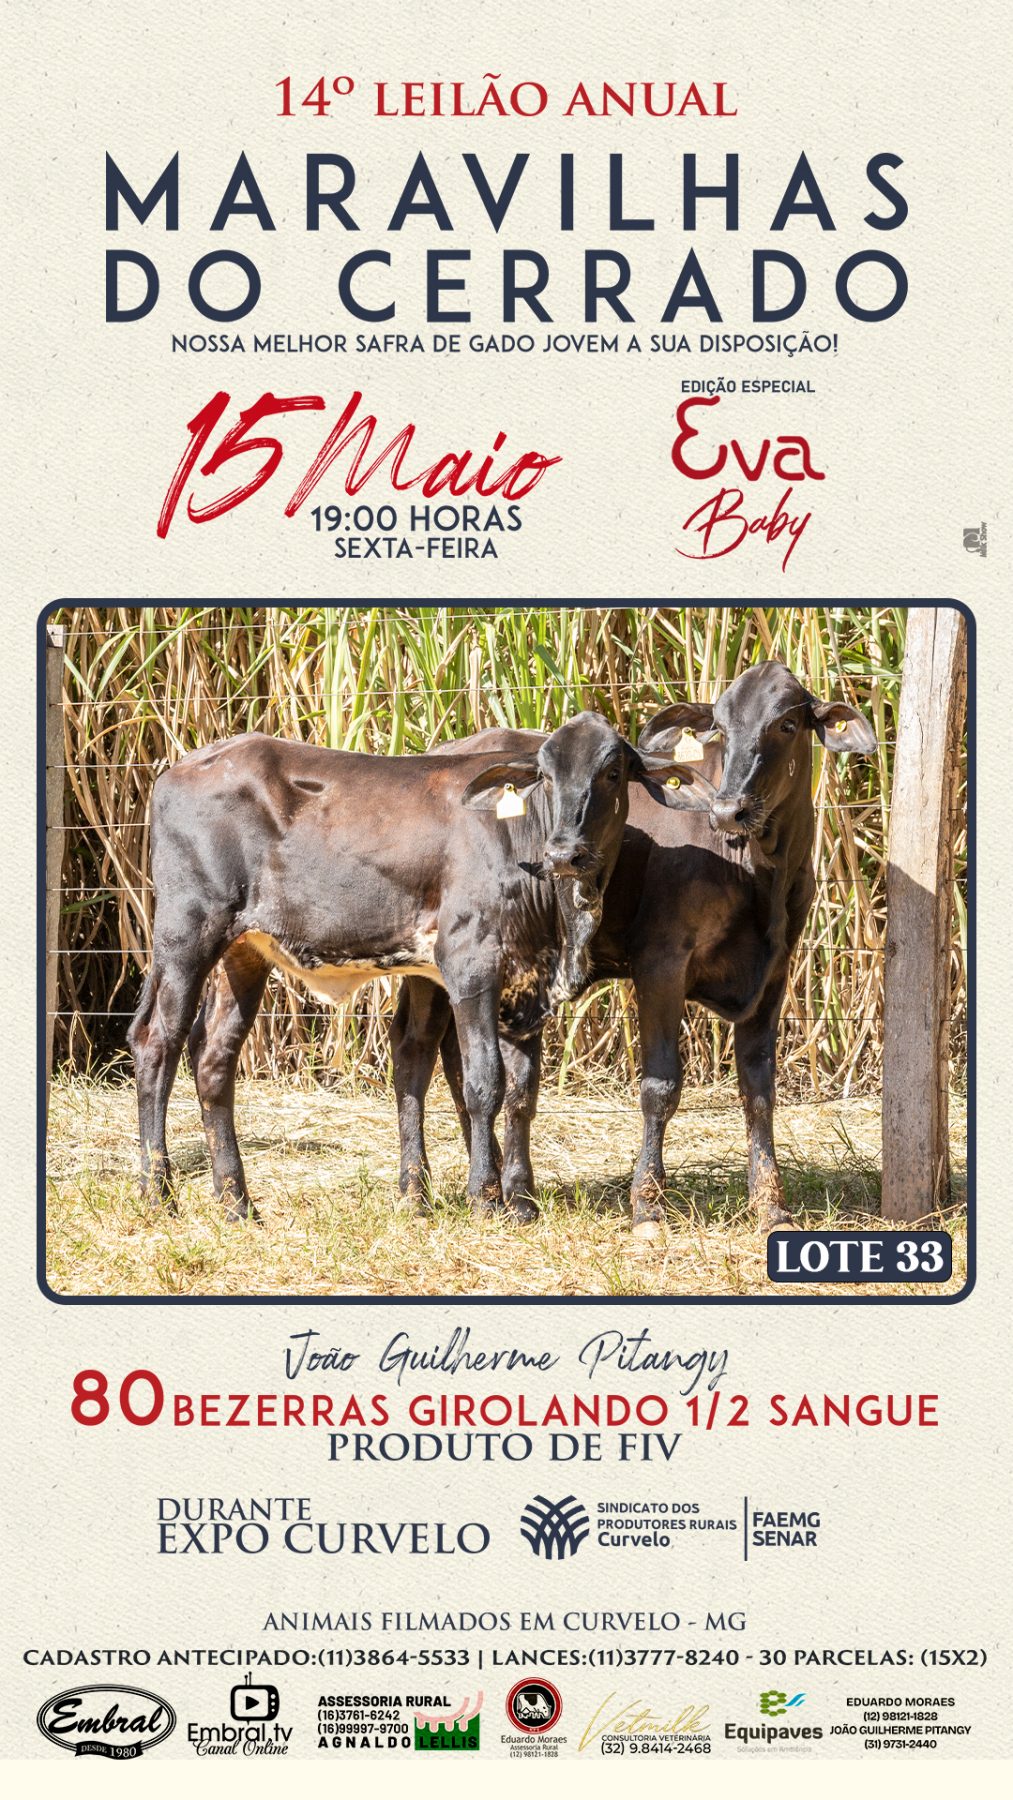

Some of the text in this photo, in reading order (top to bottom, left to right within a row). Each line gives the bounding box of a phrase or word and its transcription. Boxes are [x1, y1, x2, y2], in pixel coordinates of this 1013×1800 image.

[373, 72, 549, 117] LEILÃO
[562, 81, 738, 118] ANUAL
[105, 149, 909, 234] MARAVILHAS
[105, 246, 909, 324] DO CERRADO
[171, 330, 839, 358] NOSSA MELHOR SAFRA DE GADO JOVEM A SUA DISPOSIÇÃO!
[681, 376, 816, 397] EDIÇÃO ESPECIAL
[670, 395, 826, 481] Eva
[157, 391, 561, 539] 15 Maio
[310, 504, 523, 532] 19:00 HORAS
[674, 487, 813, 573] Baby
[334, 536, 499, 559] SEXTA-FEIRA
[776, 1240, 944, 1273] LOTE 33
[284, 1324, 732, 1398] João Guilherme Pitangy
[70, 1369, 939, 1431] 80 BEZERRAS GIROLANDO 1/2 SANGUE
[327, 1432, 683, 1462] PRODUTO DE FIV
[156, 1497, 312, 1522] DURANTE
[596, 1502, 701, 1514] SINDICATO DOS
[597, 1518, 738, 1534] PRODUTORES RURAIS
[752, 1511, 821, 1528] FAEMG
[157, 1522, 491, 1555] EXPO CURVELO
[597, 1530, 674, 1549] Curvelo
[751, 1530, 818, 1547] SENAR
[262, 1611, 372, 1631] ANIMAIS
[381, 1611, 512, 1632] FILMADOS
[520, 1611, 556, 1631] EM
[563, 1611, 681, 1632] CURVELO
[704, 1611, 747, 1632] MG
[22, 1649, 152, 1666] CADASTRO
[156, 1648, 470, 1668] ANTECIPADO:(11)3864-5533
[492, 1648, 740, 1668] LANCES:(11)3777-8240
[759, 1649, 787, 1666] 30
[794, 1649, 914, 1666] PARCELAS:
[920, 1648, 988, 1668] (15X2)
[317, 1695, 452, 1708] ASSESSORIA RURAL
[846, 1696, 956, 1708] EDUARDO MORAES
[48, 1697, 166, 1736] Embral
[317, 1708, 401, 1722] (16)3761-6242
[578, 1691, 711, 1752] Vetmilk
[863, 1711, 939, 1723] (12) 98121-1828
[186, 1722, 294, 1744] Embral.tv
[317, 1722, 409, 1736] (16)99997-9700
[501, 1735, 568, 1744] Eduardo Moraes
[660, 1732, 711, 1742] VETERINÁRIA
[725, 1723, 823, 1744] Equipaves
[829, 1723, 972, 1736] JOÃO GUILHERME PITANGY
[80, 1743, 137, 1758] DESDE 1980
[192, 1739, 290, 1757] Canal Online
[317, 1736, 478, 1749] AGNALDO LELLIS
[600, 1741, 711, 1756] (32) 9.8414-2468
[864, 1738, 938, 1751] (31) 9731-2440
